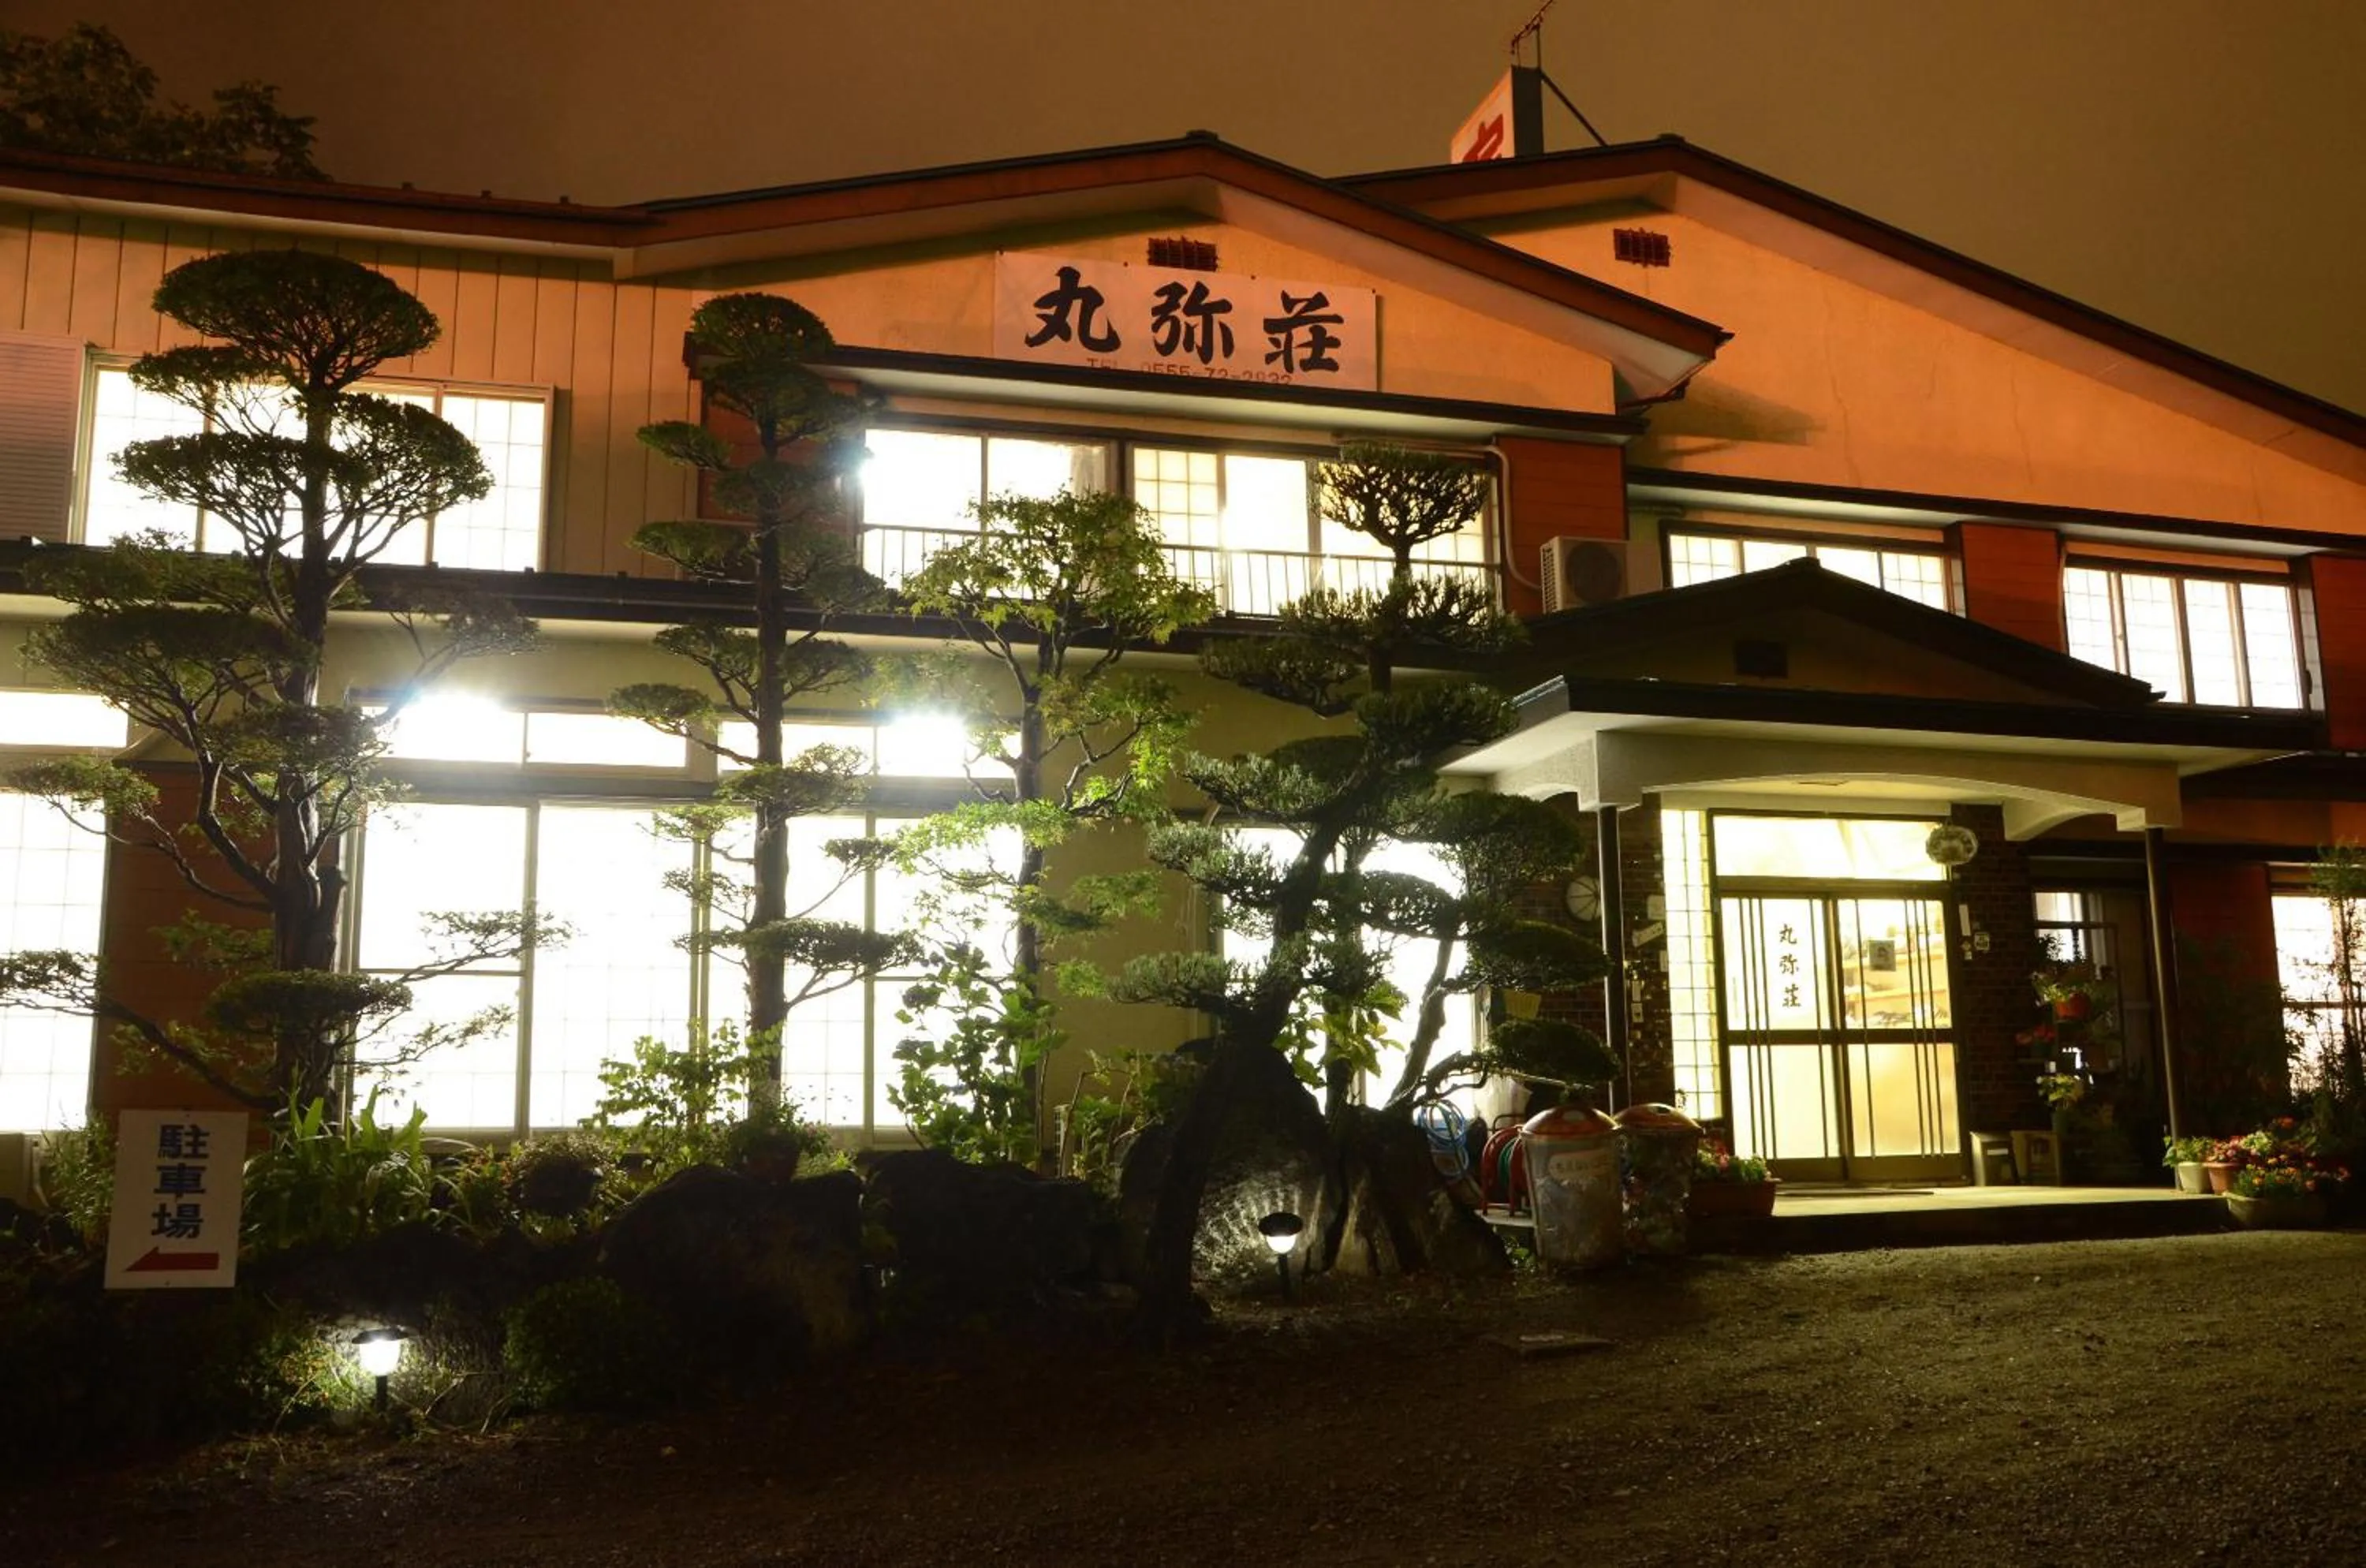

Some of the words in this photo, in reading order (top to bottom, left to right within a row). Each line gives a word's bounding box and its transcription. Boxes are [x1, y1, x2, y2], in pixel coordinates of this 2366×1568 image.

[1025, 266, 1344, 373] 丸弥荘
[1779, 923, 1802, 1008] 丸弥荘
[151, 1124, 211, 1238] 駐車場
